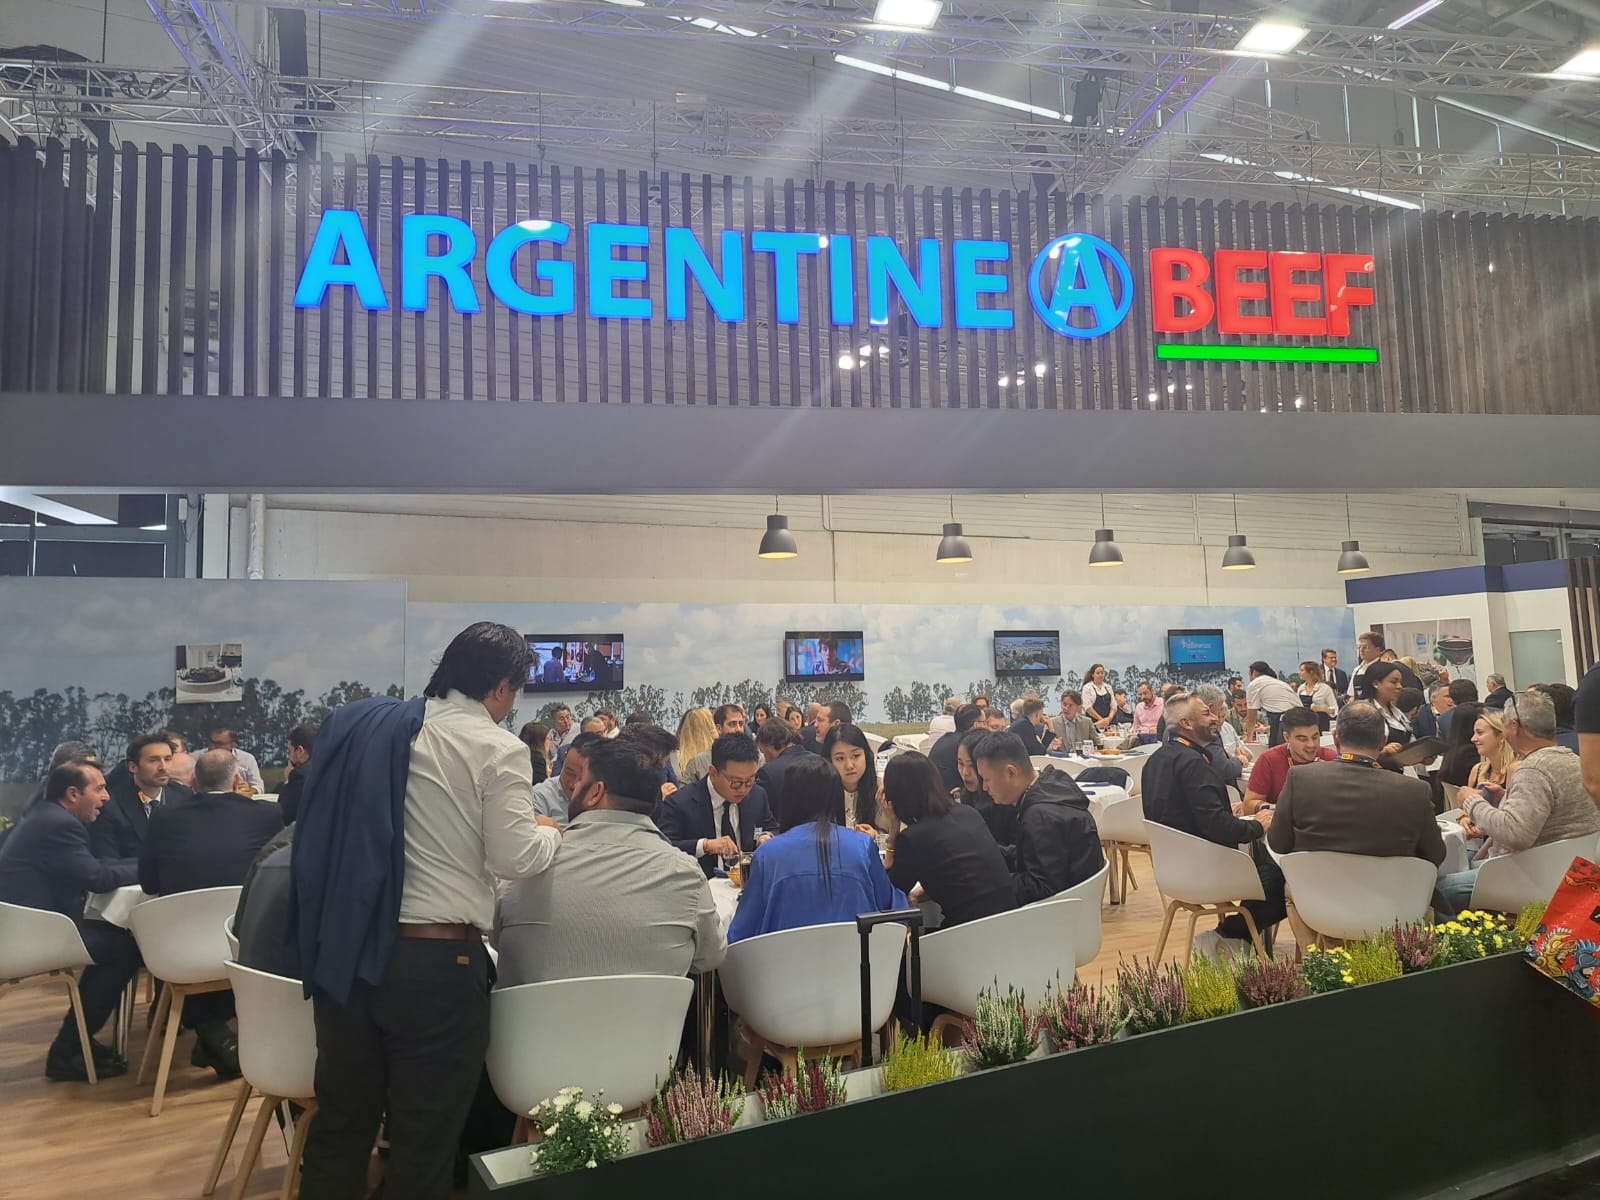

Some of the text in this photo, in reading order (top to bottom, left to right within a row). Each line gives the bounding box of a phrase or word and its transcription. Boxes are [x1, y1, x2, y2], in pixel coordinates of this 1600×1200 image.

[293, 209, 1376, 337] ARGENTINE A BEEF
